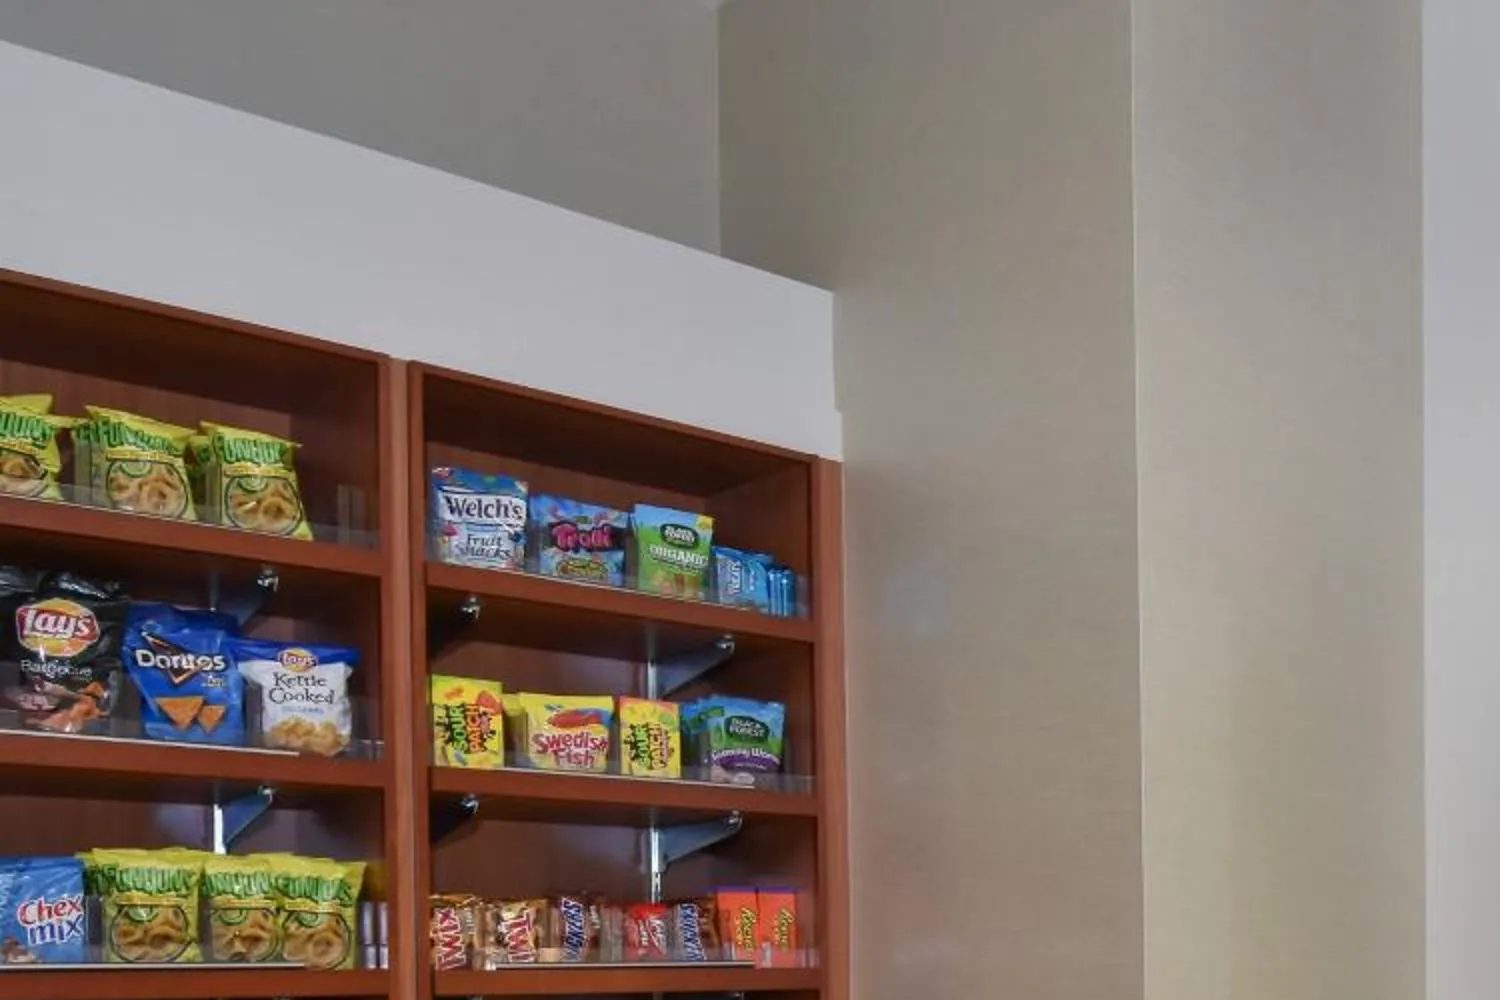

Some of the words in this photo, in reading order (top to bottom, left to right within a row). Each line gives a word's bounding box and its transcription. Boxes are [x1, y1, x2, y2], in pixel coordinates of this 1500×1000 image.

[445, 496, 525, 520] Welch's
[22, 607, 92, 640] Lay's
[135, 648, 227, 672] Doritos
[272, 671, 328, 689] Kettle
[268, 687, 335, 706] Cooked
[532, 732, 609, 752] Swedish
[552, 747, 595, 767] Fish
[18, 896, 83, 925] Chex
